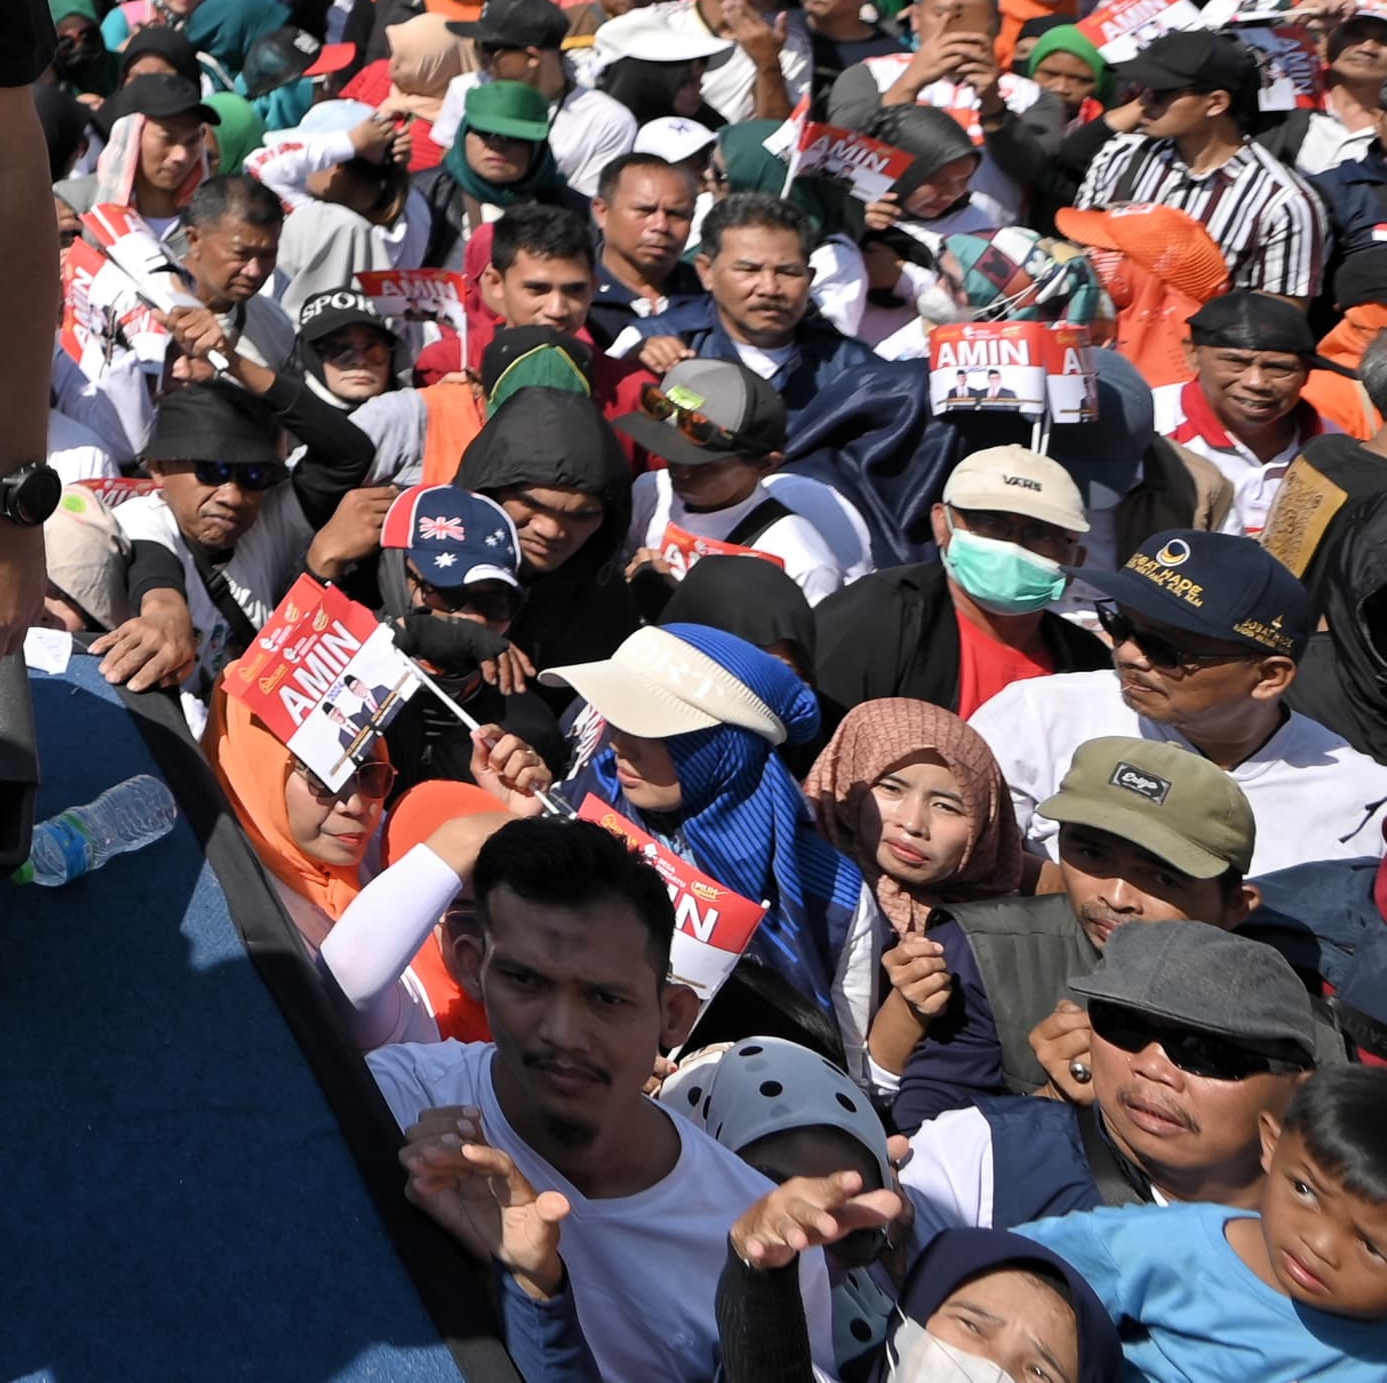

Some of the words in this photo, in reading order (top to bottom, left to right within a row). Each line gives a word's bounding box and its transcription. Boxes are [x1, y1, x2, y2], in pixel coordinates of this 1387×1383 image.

[1281, 40, 1314, 96] AMIN
[810, 135, 891, 175] AMIN
[938, 338, 1029, 368] AMIN
[279, 619, 364, 728] AMIN
